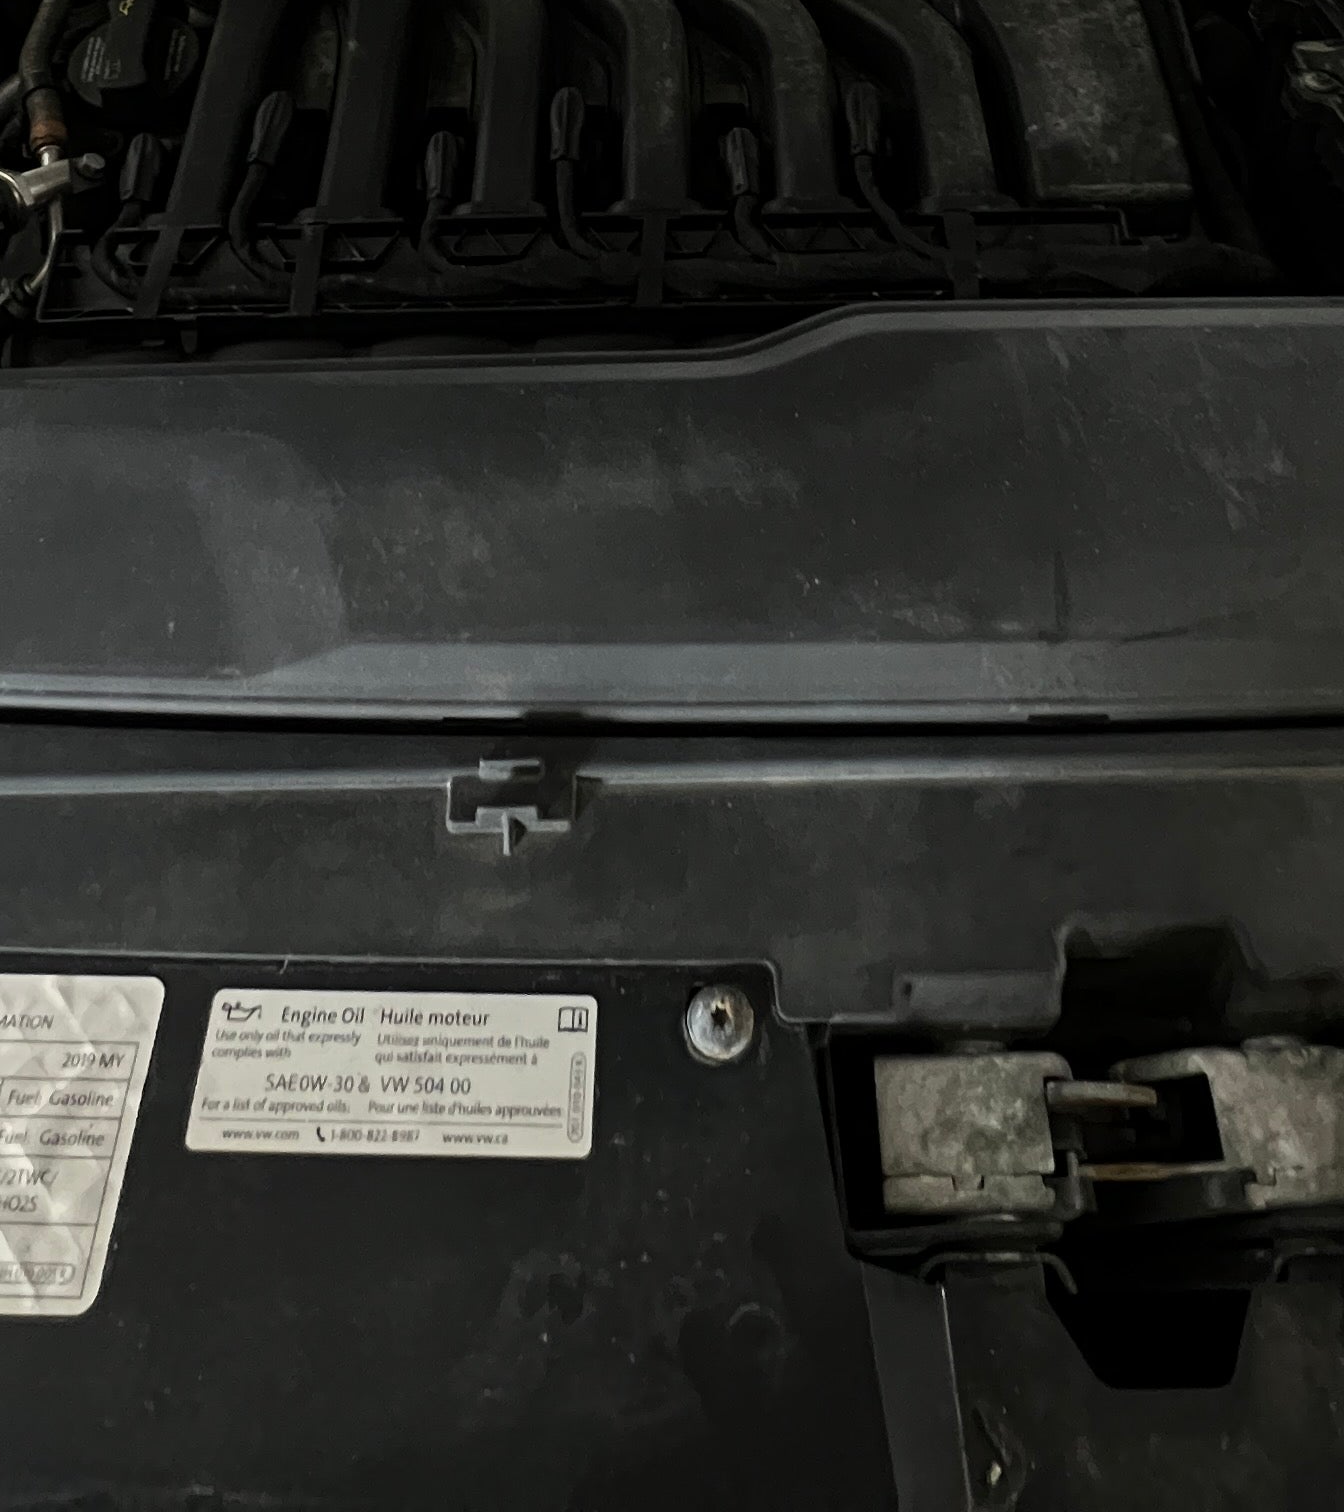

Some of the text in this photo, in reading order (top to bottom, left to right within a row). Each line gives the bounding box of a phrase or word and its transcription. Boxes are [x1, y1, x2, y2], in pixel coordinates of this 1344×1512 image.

[280, 1005, 364, 1028] Engine Oil
[380, 1006, 489, 1026] Huile moteur
[215, 1028, 361, 1047] Use only oil that expressly
[422, 1033, 493, 1050] uniquement
[497, 1034, 511, 1048] de
[62, 1052, 123, 1068] 2019 MY
[211, 1046, 291, 1061] complies with
[374, 1050, 393, 1065] qui
[396, 1049, 442, 1063] satisfait
[357, 1075, 370, 1093] &
[380, 1075, 409, 1093] VW
[413, 1075, 444, 1094] 504
[450, 1076, 470, 1095] 00
[48, 1090, 113, 1106] Gasoline
[201, 1096, 220, 1110] For
[233, 1096, 250, 1111] list
[253, 1096, 266, 1111] of
[268, 1098, 324, 1115] approved
[368, 1099, 394, 1114] Pour
[397, 1101, 418, 1114] une
[421, 1100, 445, 1115] liste
[39, 1129, 105, 1146] Gasoline
[221, 1127, 299, 1141] www.vw.com
[442, 1131, 508, 1145] www.vw.ca
